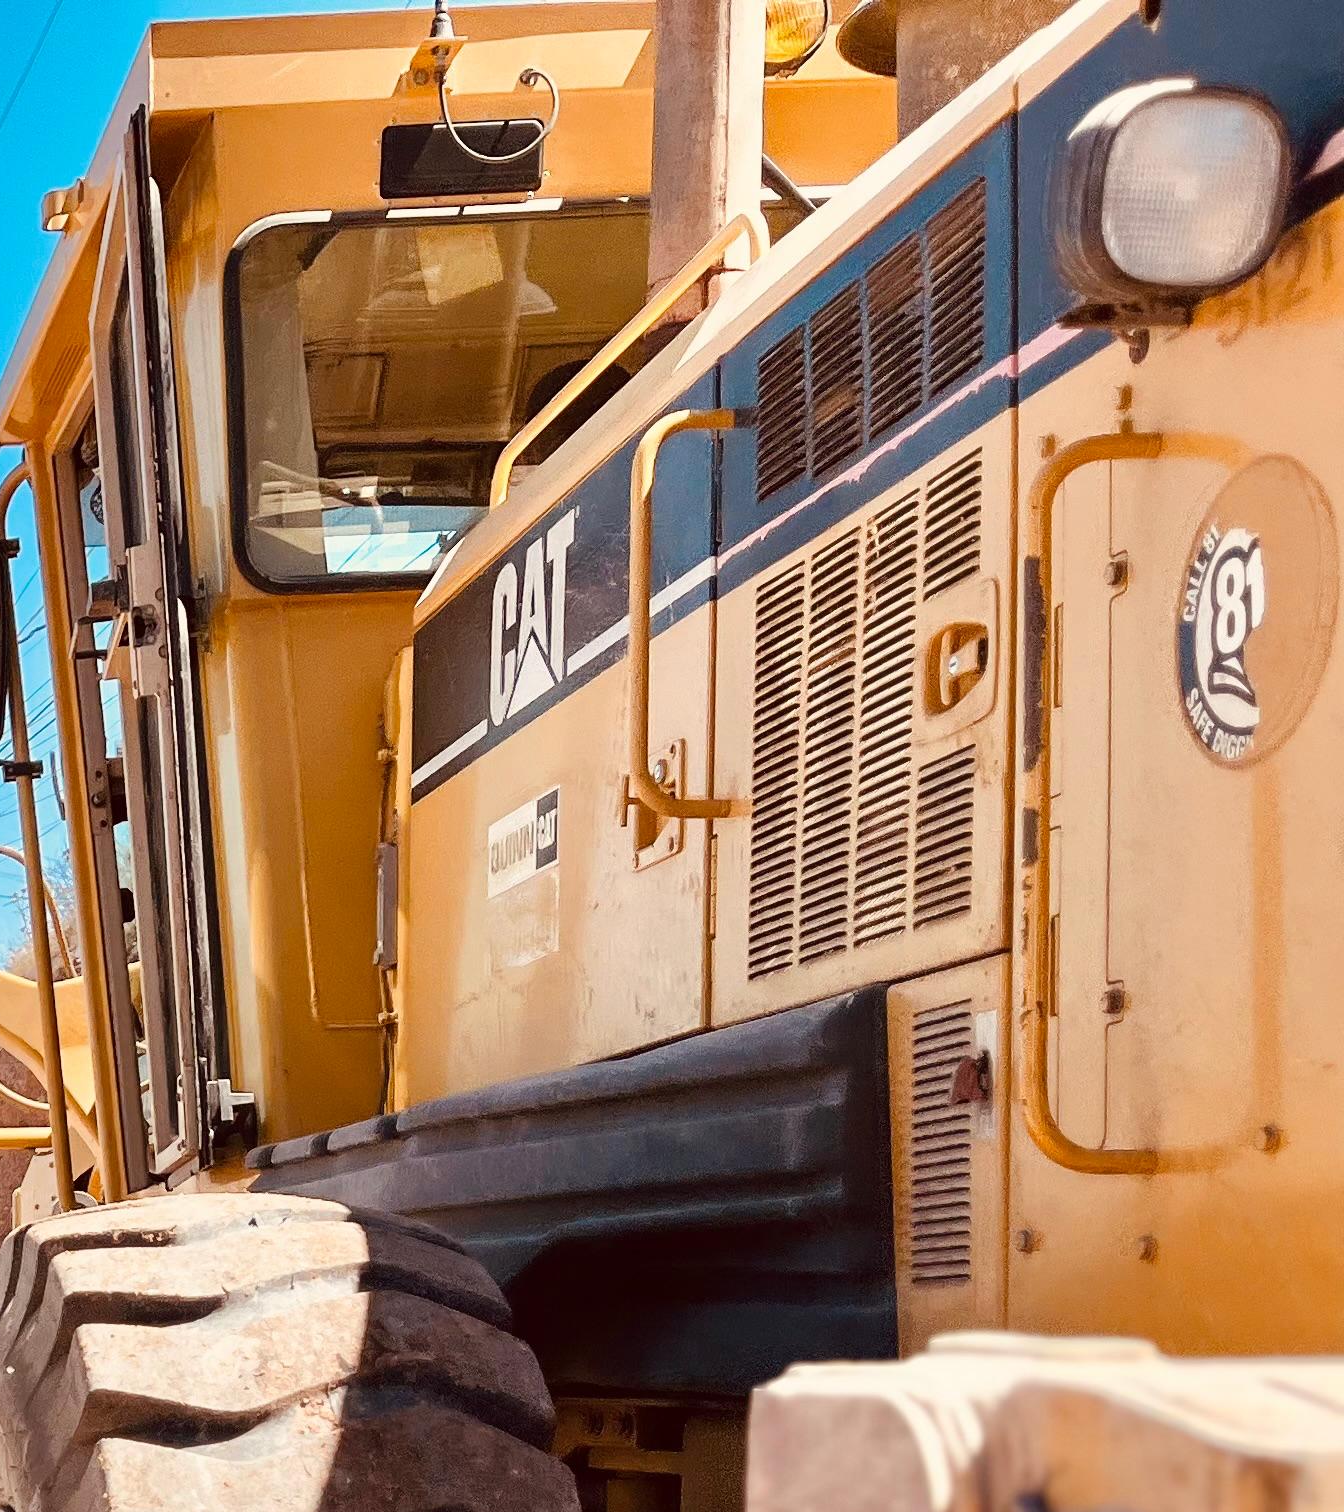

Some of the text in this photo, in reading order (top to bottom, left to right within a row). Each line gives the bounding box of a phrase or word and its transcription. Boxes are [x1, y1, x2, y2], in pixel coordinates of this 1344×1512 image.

[489, 507, 575, 727] CAT
[1183, 558, 1208, 622] CALL
[1186, 688, 1215, 743] SAFE
[491, 806, 558, 876] QUINN CAT
